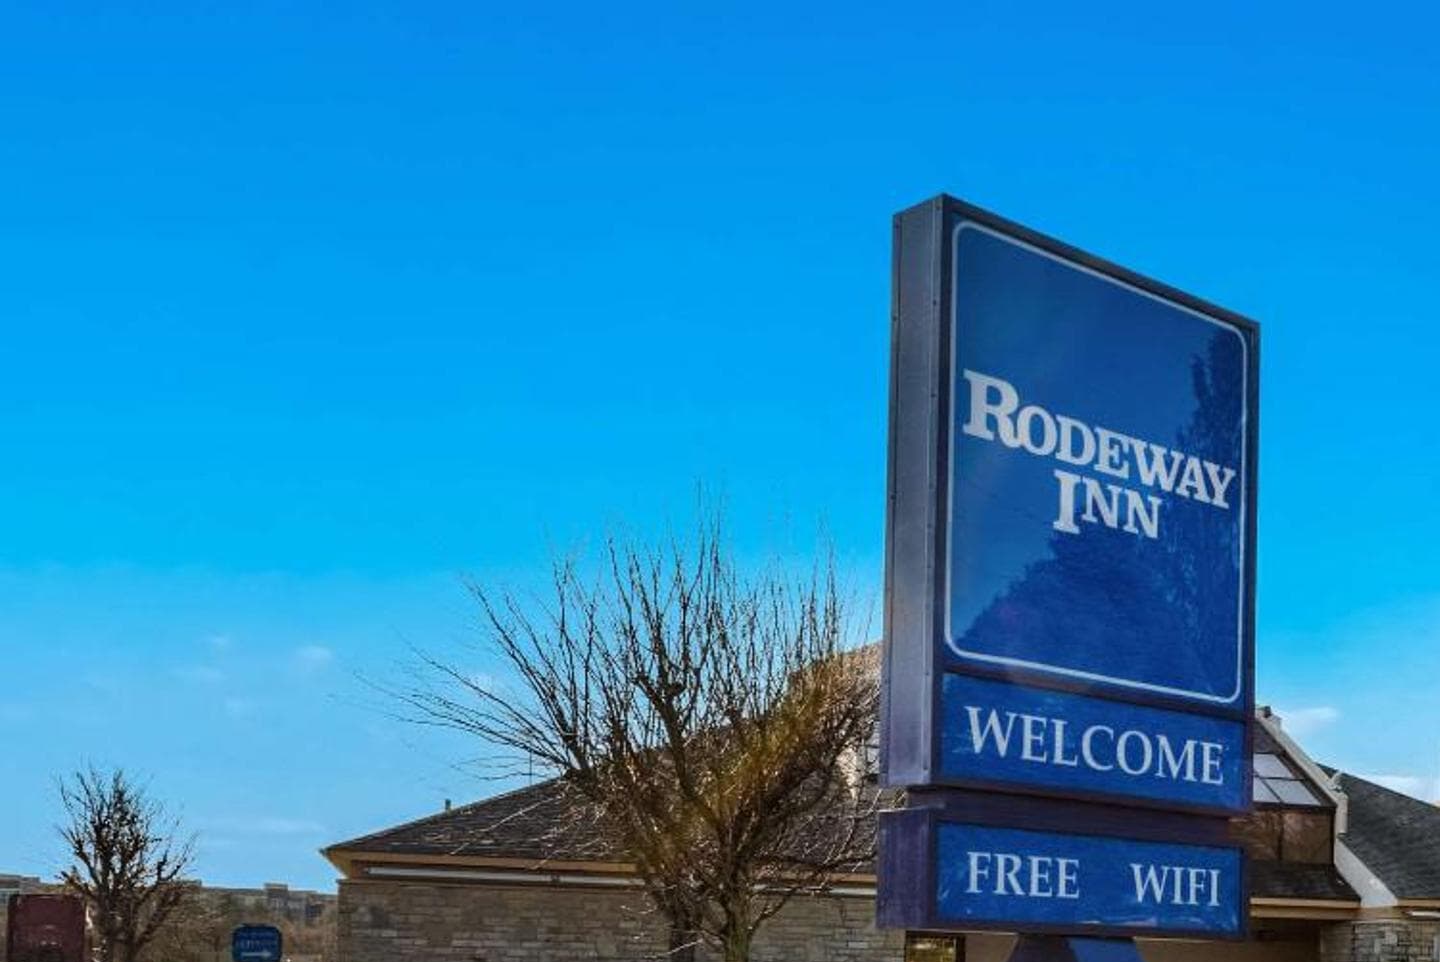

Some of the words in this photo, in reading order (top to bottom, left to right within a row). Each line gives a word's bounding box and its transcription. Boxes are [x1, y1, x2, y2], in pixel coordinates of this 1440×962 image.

[963, 369, 1235, 509] RODEWAY
[1053, 470, 1162, 539] INN
[966, 706, 1224, 785] WELCOME
[966, 852, 1080, 899] FREE
[1130, 863, 1220, 907] WIFI
